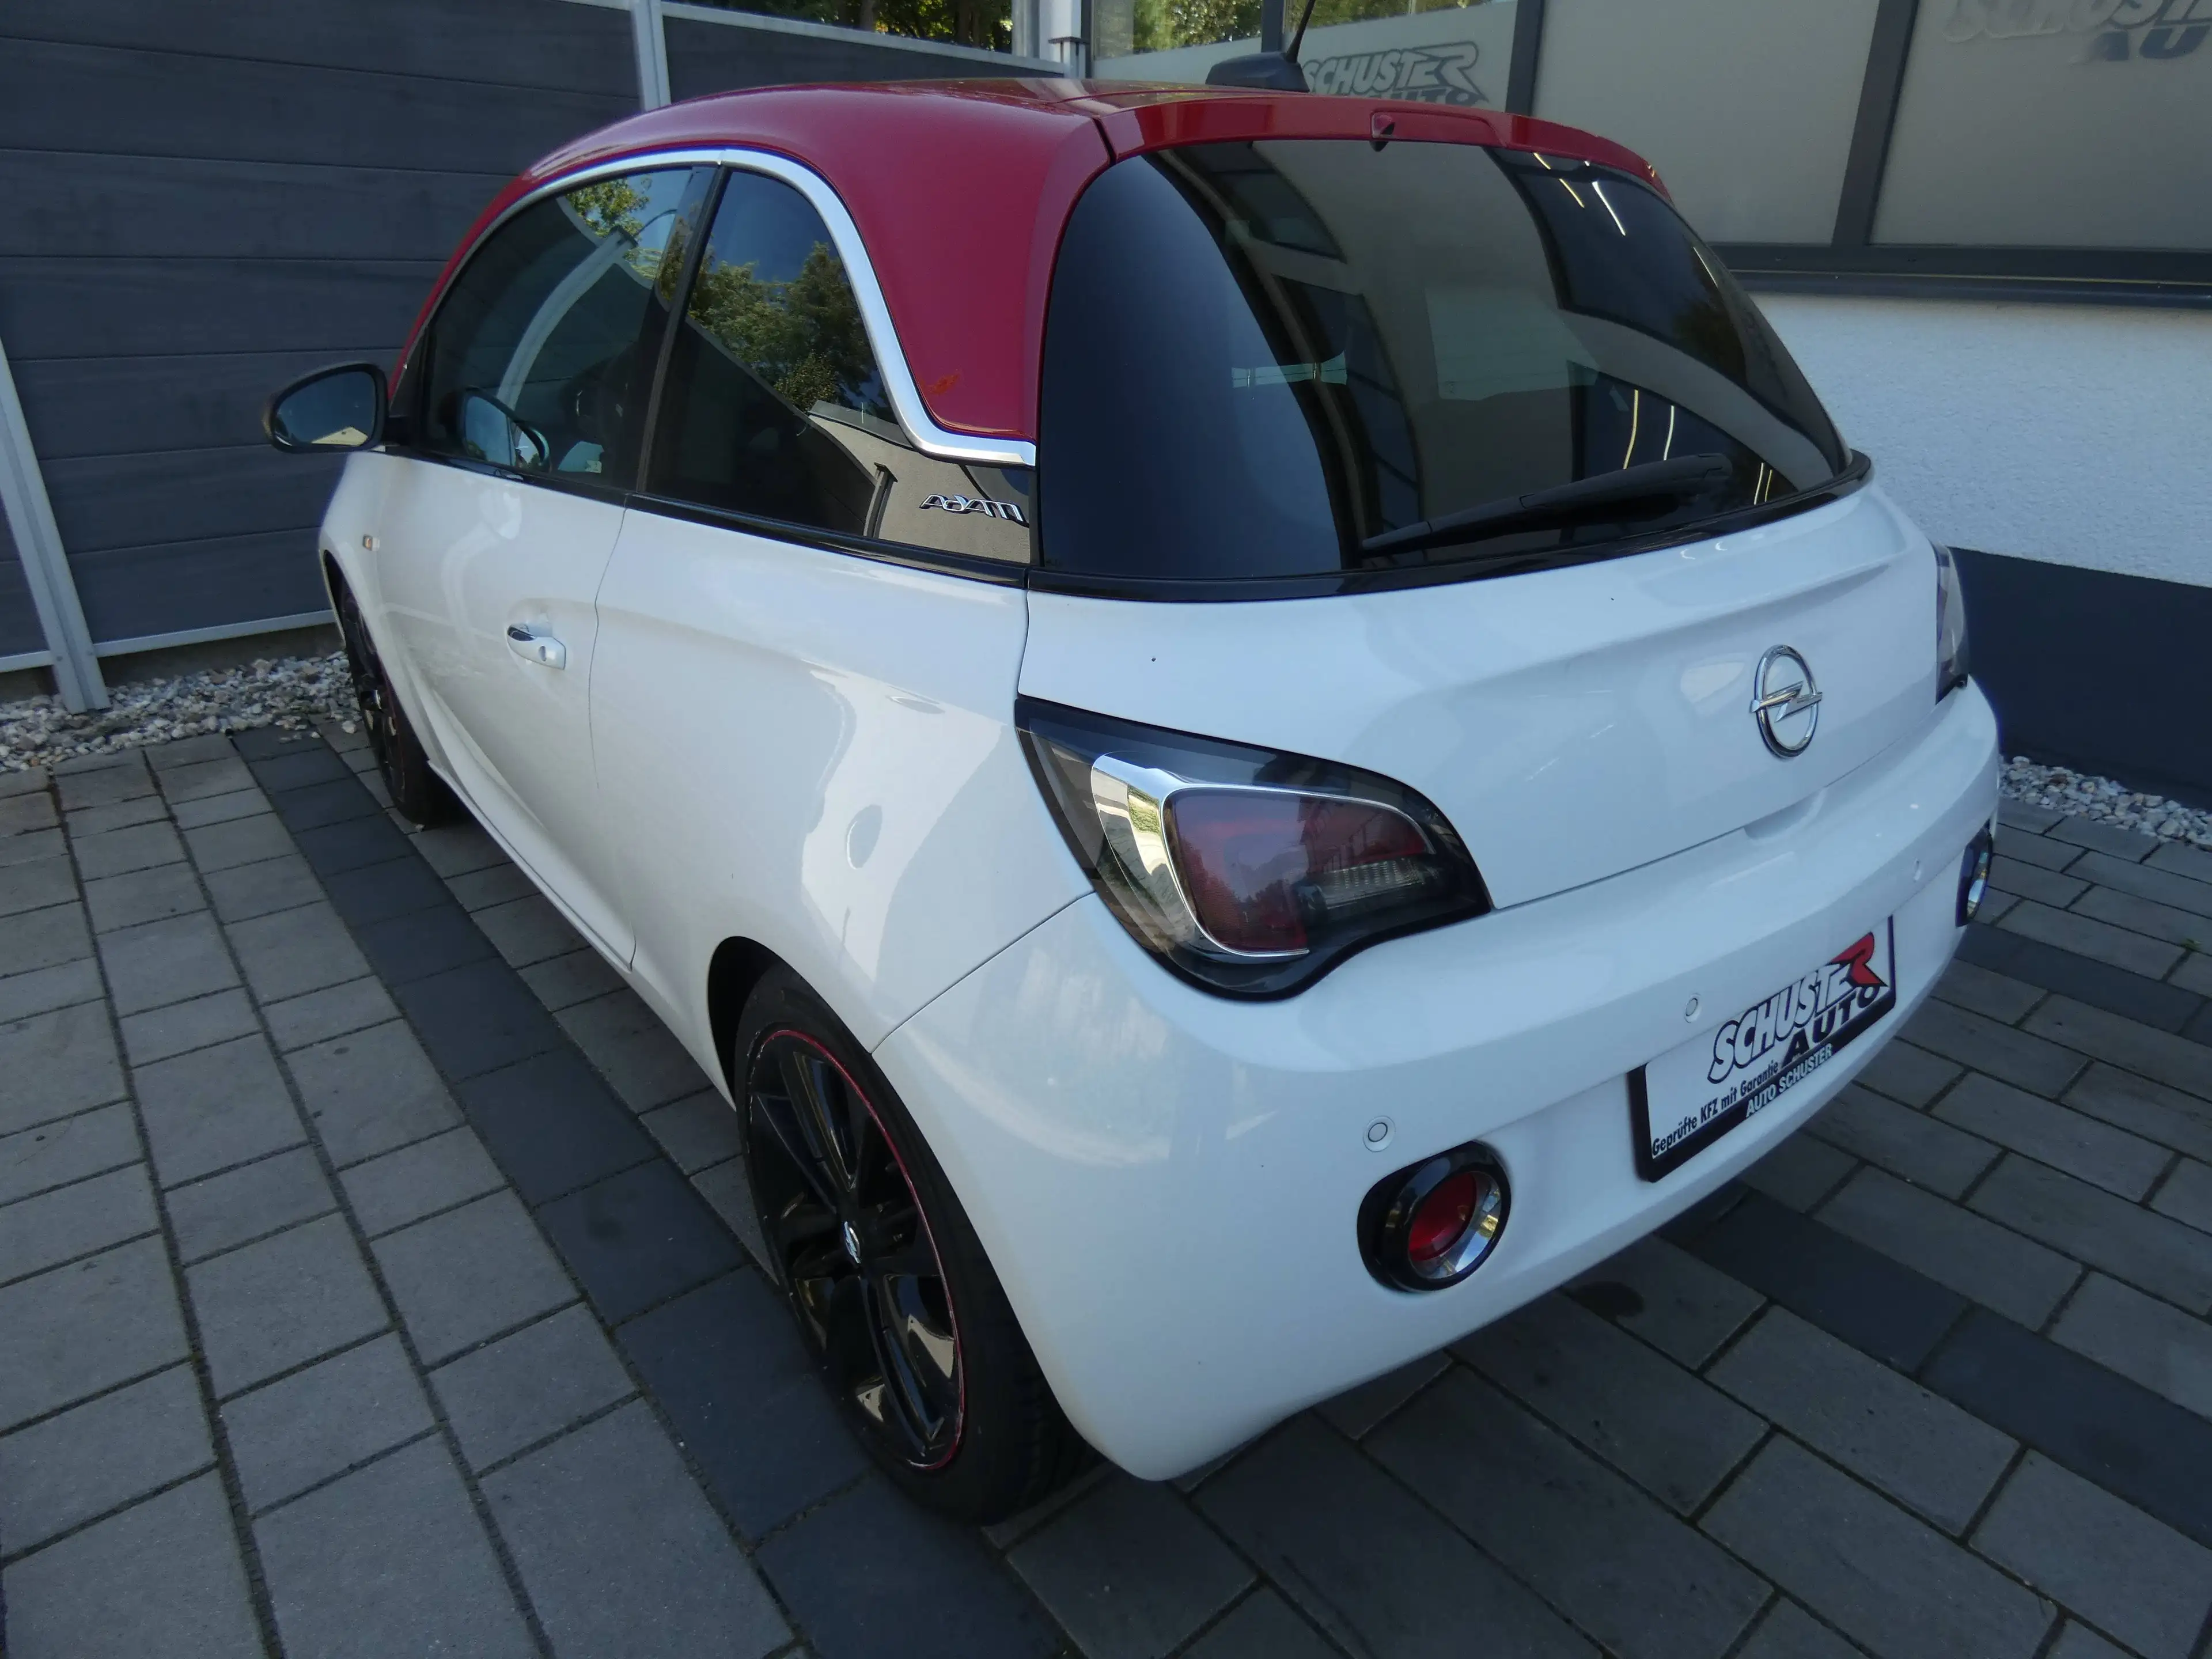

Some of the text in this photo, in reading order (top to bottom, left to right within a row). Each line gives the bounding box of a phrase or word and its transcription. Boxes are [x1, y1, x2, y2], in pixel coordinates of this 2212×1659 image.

[1707, 931, 1888, 1084] SCHUSTER
[1783, 986, 1881, 1066] AUTO
[1652, 1059, 1779, 1156] Geprüfte KFZ mit Garantie
[1746, 1043, 1832, 1118] AUTO SCHUSTER
